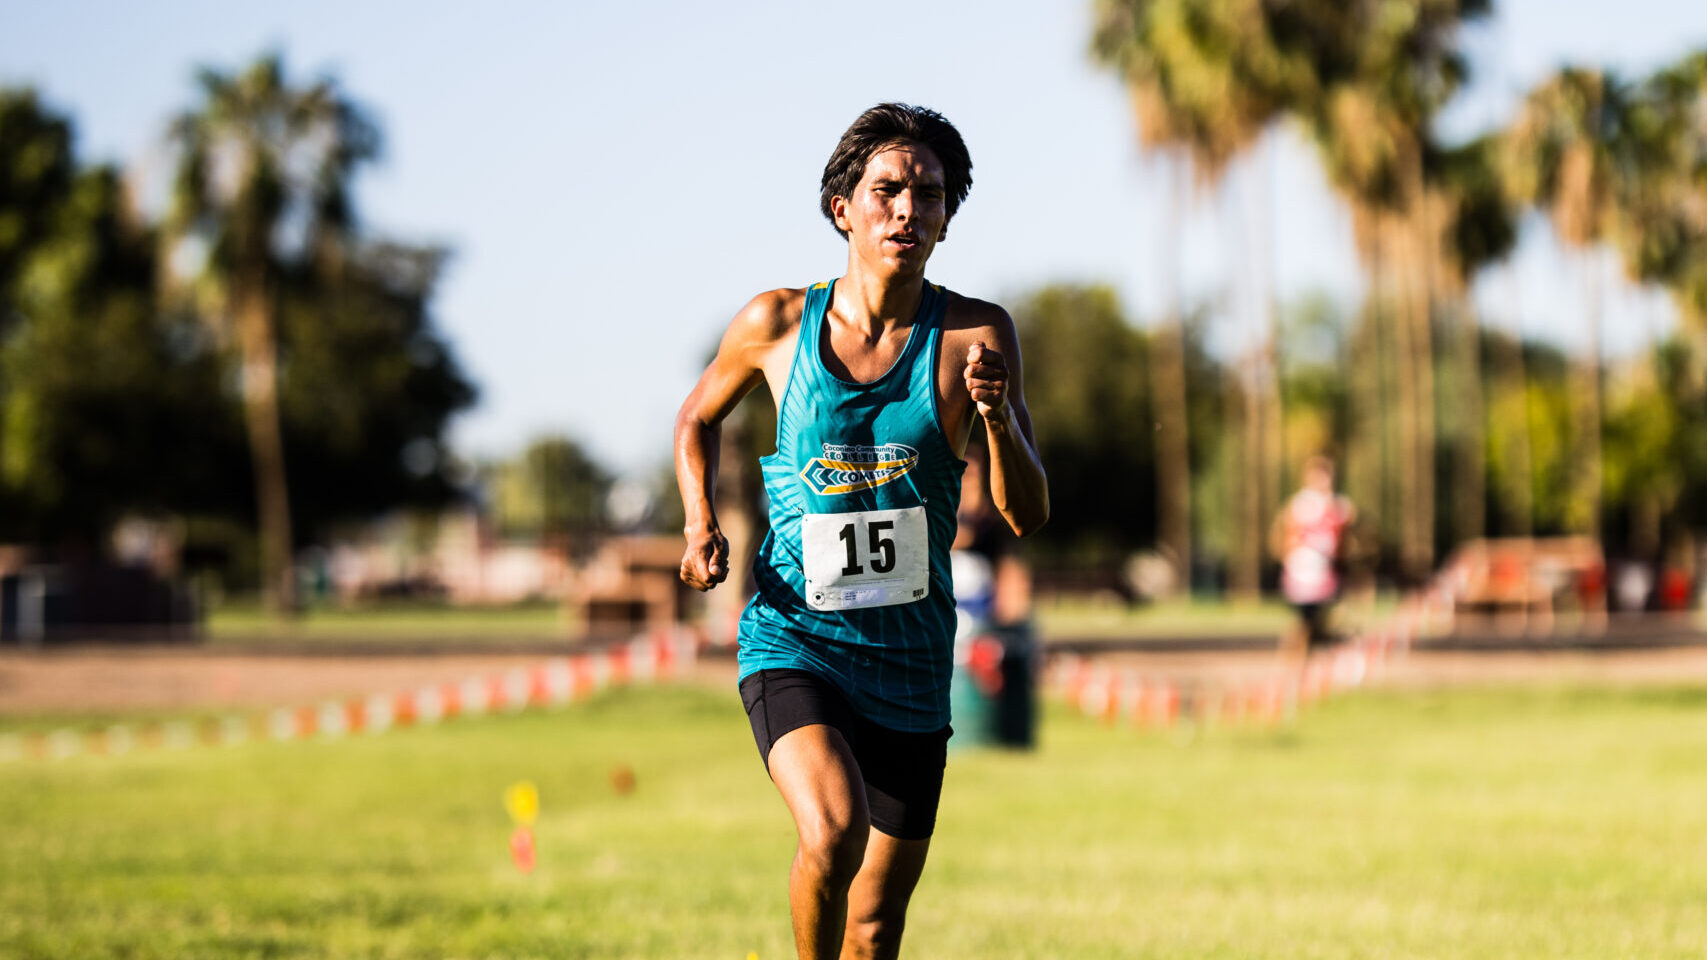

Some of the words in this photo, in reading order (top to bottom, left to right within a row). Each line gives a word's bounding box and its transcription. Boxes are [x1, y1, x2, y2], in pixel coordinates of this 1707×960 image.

[823, 444, 855, 452] Coconino
[856, 444, 896, 453] Community
[823, 452, 896, 460] COLLEGE
[839, 521, 896, 576] 15
